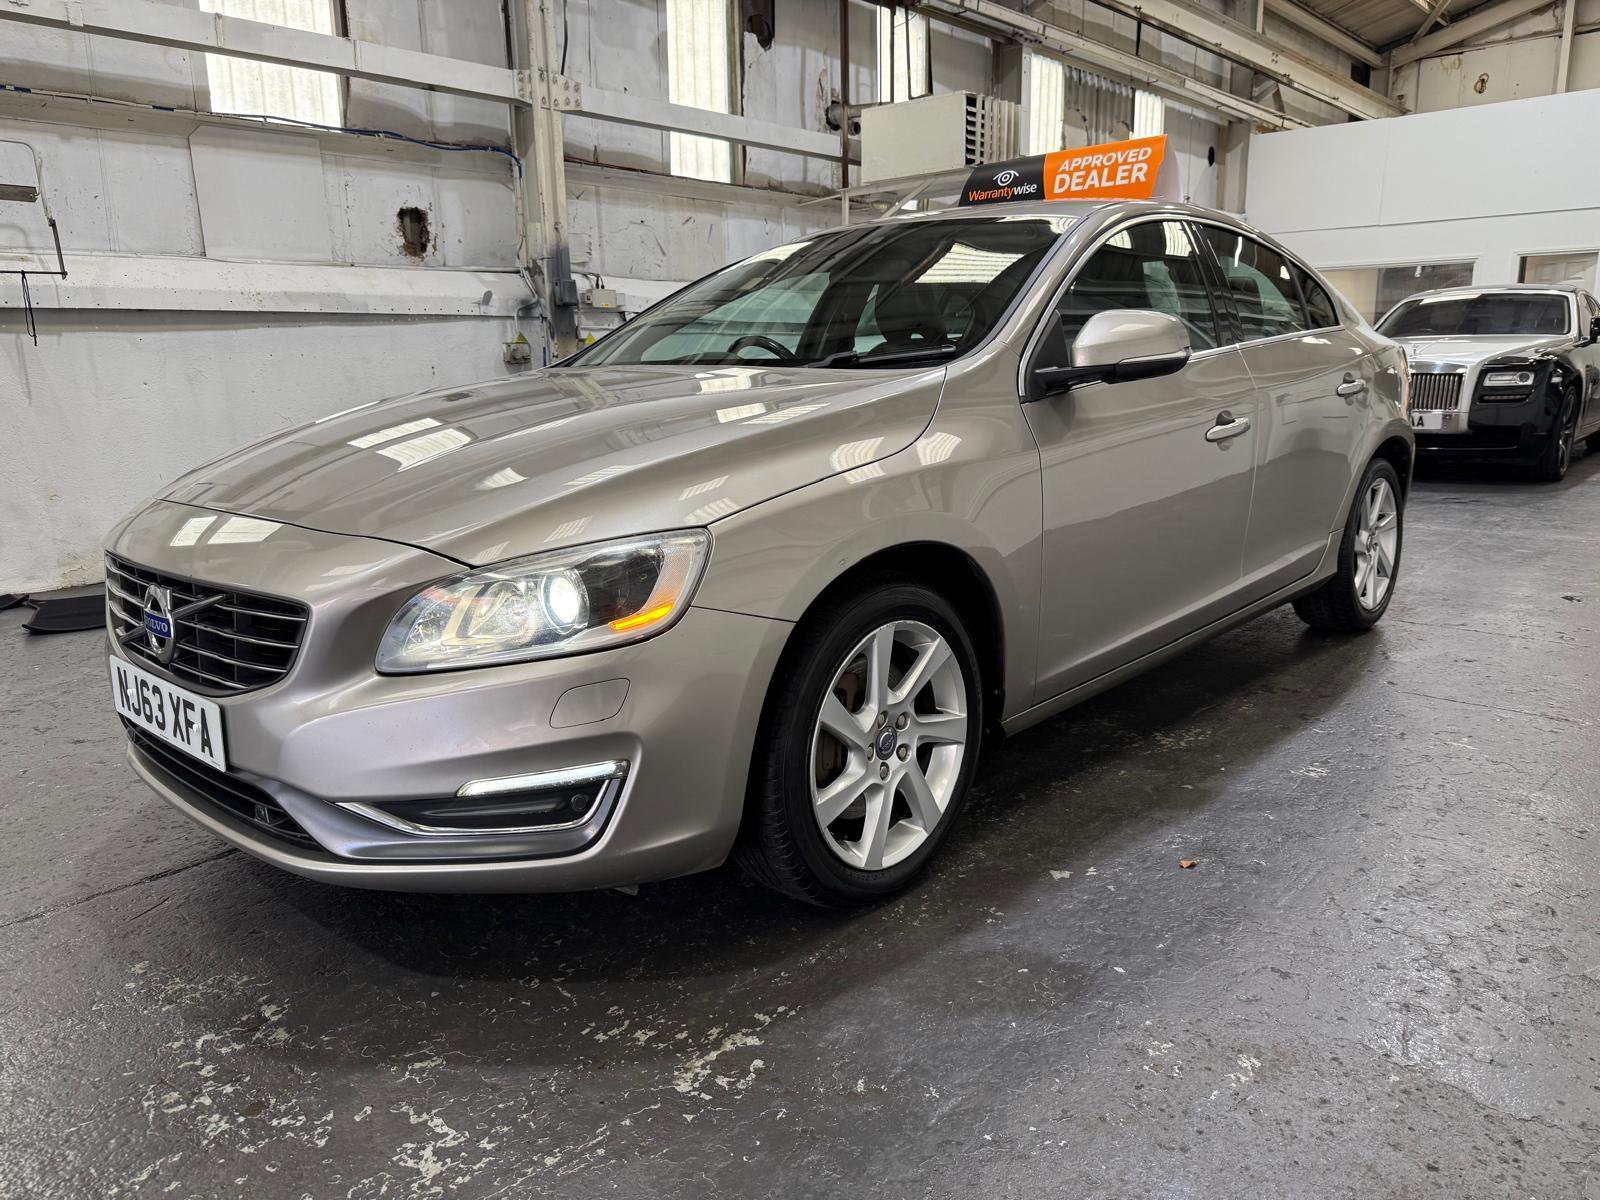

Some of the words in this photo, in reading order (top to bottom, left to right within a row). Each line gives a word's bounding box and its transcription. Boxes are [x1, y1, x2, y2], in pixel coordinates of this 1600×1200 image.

[1058, 147, 1152, 172] APPROVED
[968, 182, 1037, 202] Warrantywise
[1053, 162, 1147, 194] DEALER
[116, 666, 167, 732] NJ63
[168, 691, 214, 758] XFA
